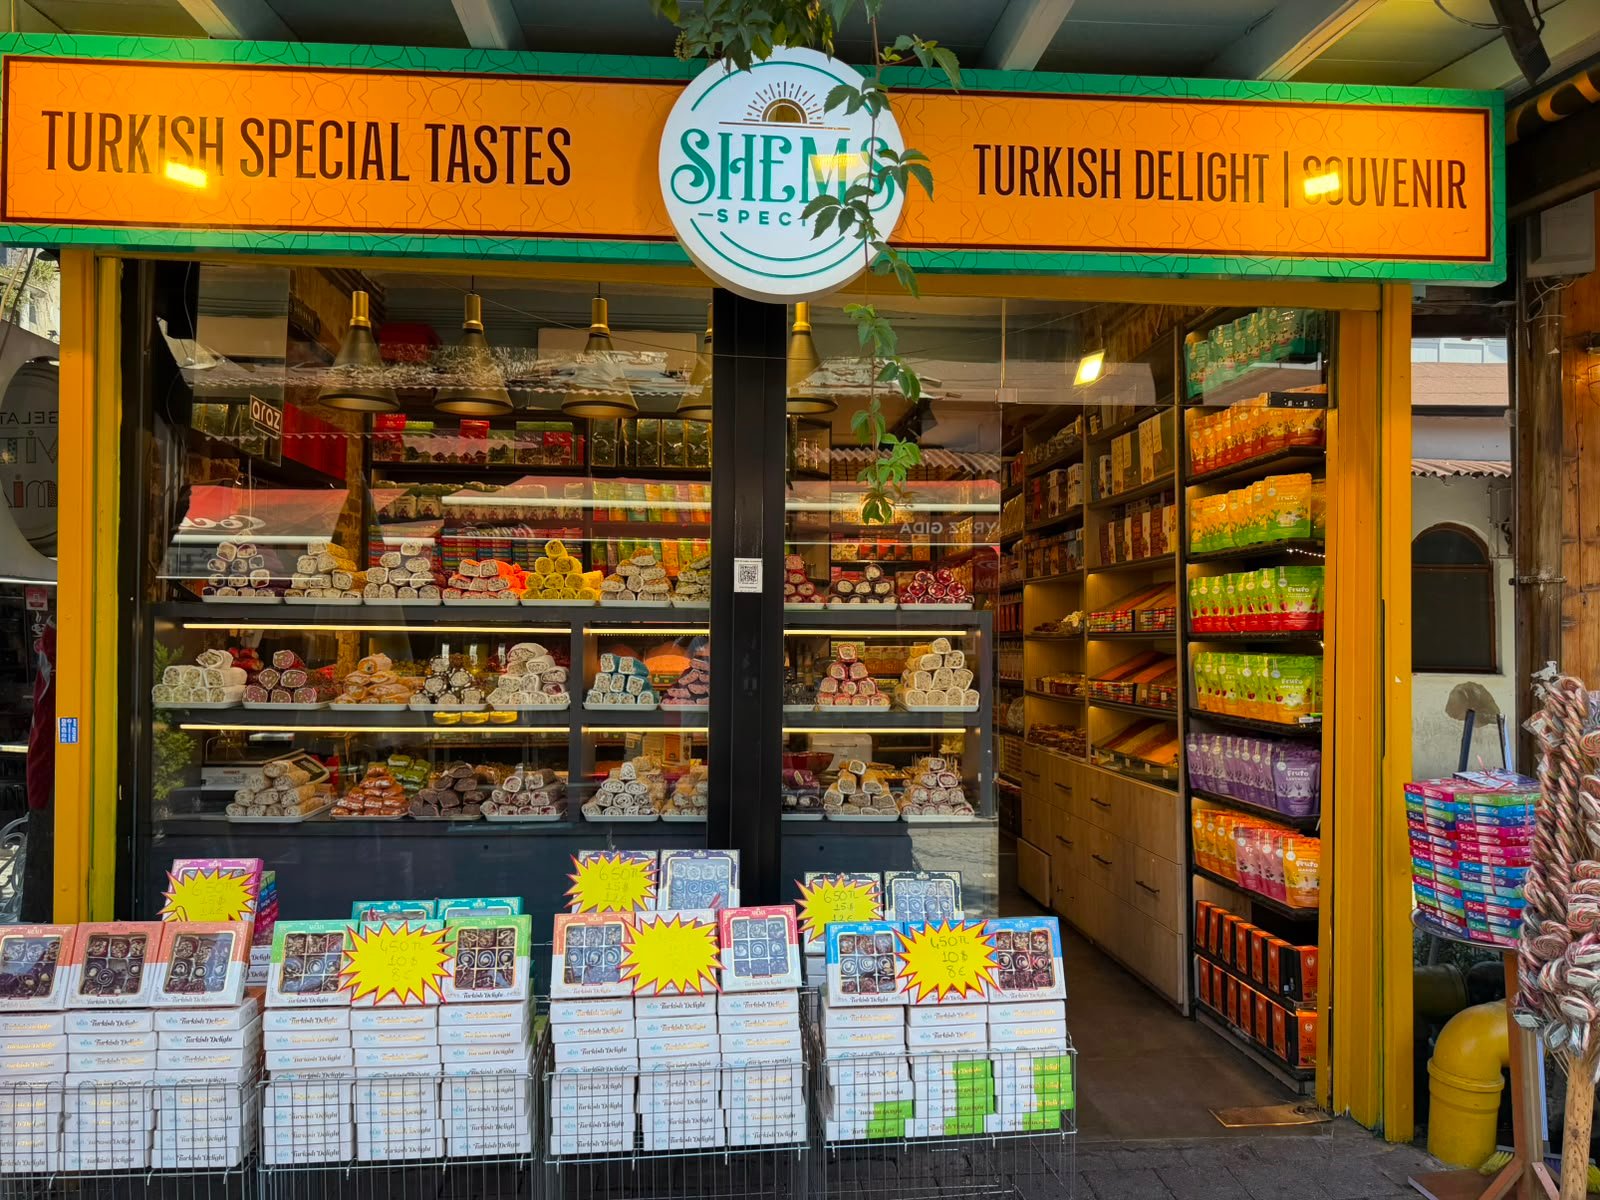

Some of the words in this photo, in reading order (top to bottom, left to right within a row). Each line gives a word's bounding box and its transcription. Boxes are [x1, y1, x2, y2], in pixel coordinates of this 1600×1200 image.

[41, 110, 224, 176] TURKISH
[240, 117, 409, 181] SPECIAL
[425, 123, 571, 186] TASTES
[670, 128, 895, 212] SHEMS
[973, 144, 1121, 199] TURKISH
[1135, 149, 1269, 204] DELIGHT
[1303, 154, 1467, 209] SOUVENIR
[209, 1035, 232, 1043] Delight
